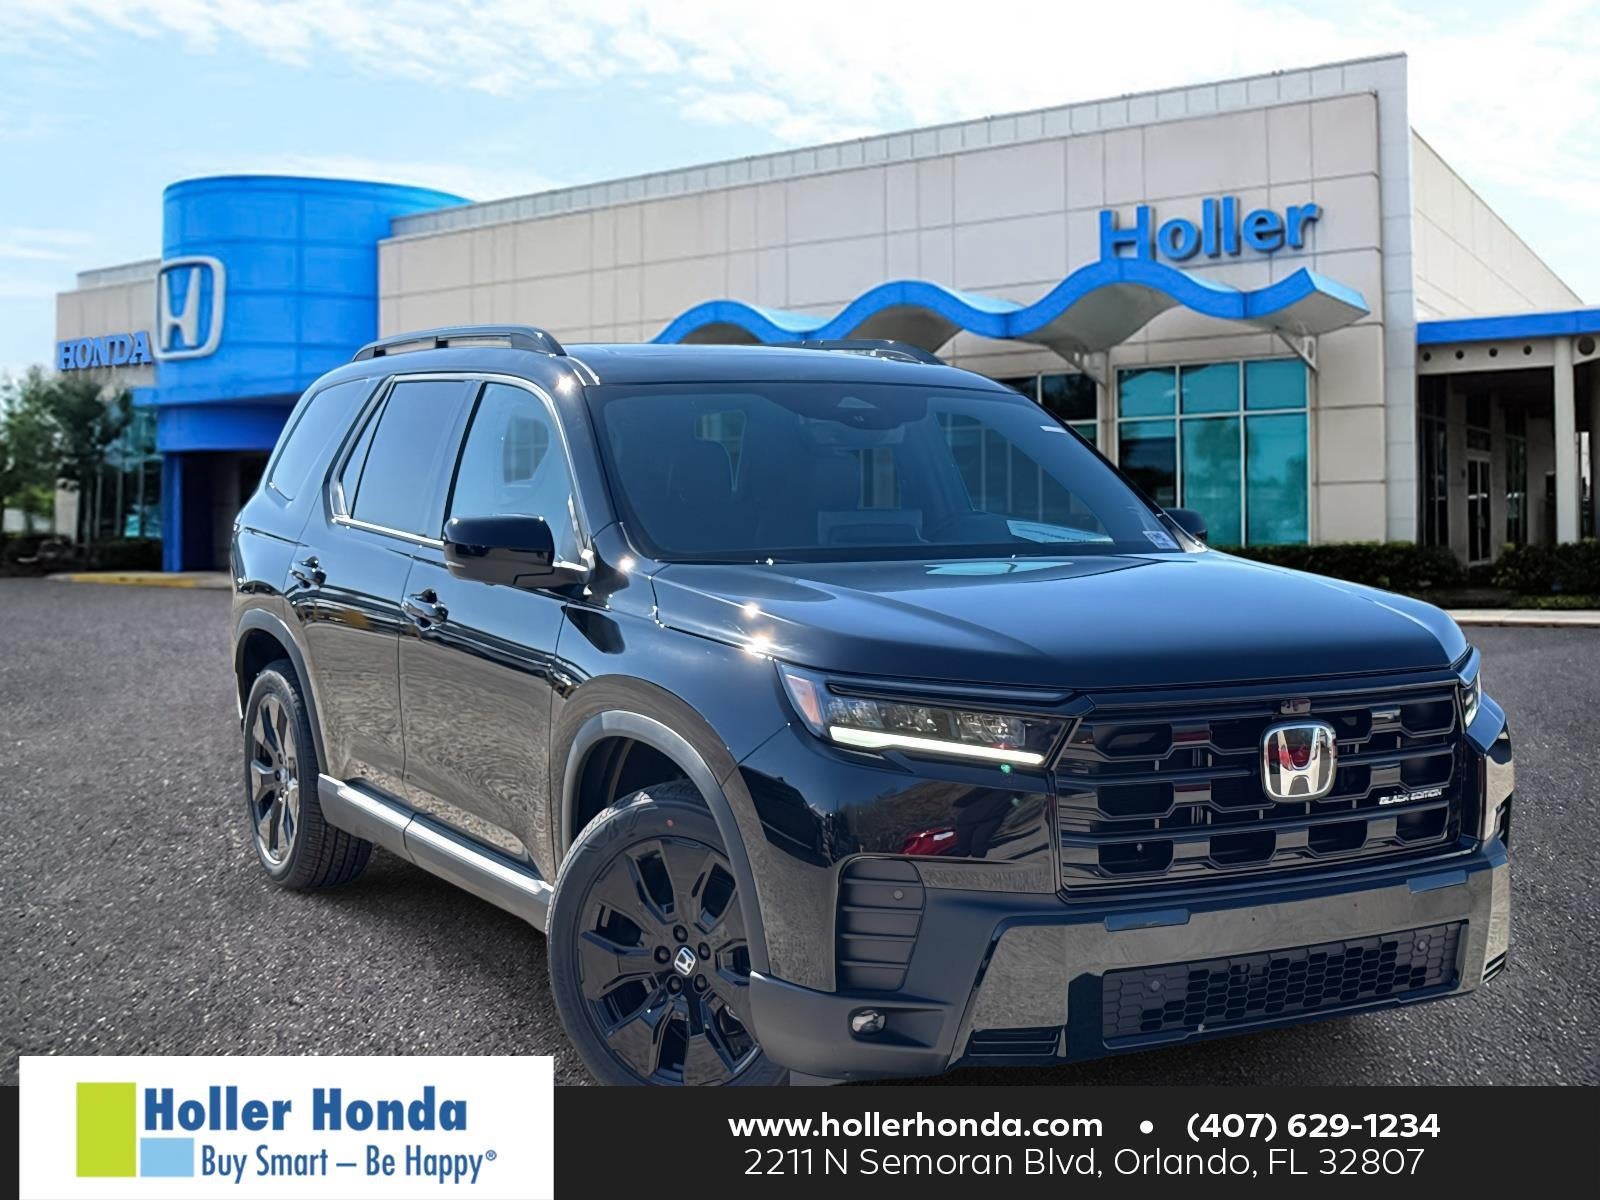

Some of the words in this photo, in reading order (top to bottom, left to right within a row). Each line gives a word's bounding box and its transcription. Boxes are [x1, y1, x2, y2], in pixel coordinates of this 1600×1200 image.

[1100, 195, 1322, 261] Holler
[56, 330, 153, 371] HONDA
[1378, 793, 1410, 805] BLACK
[1410, 788, 1443, 801] EDITION
